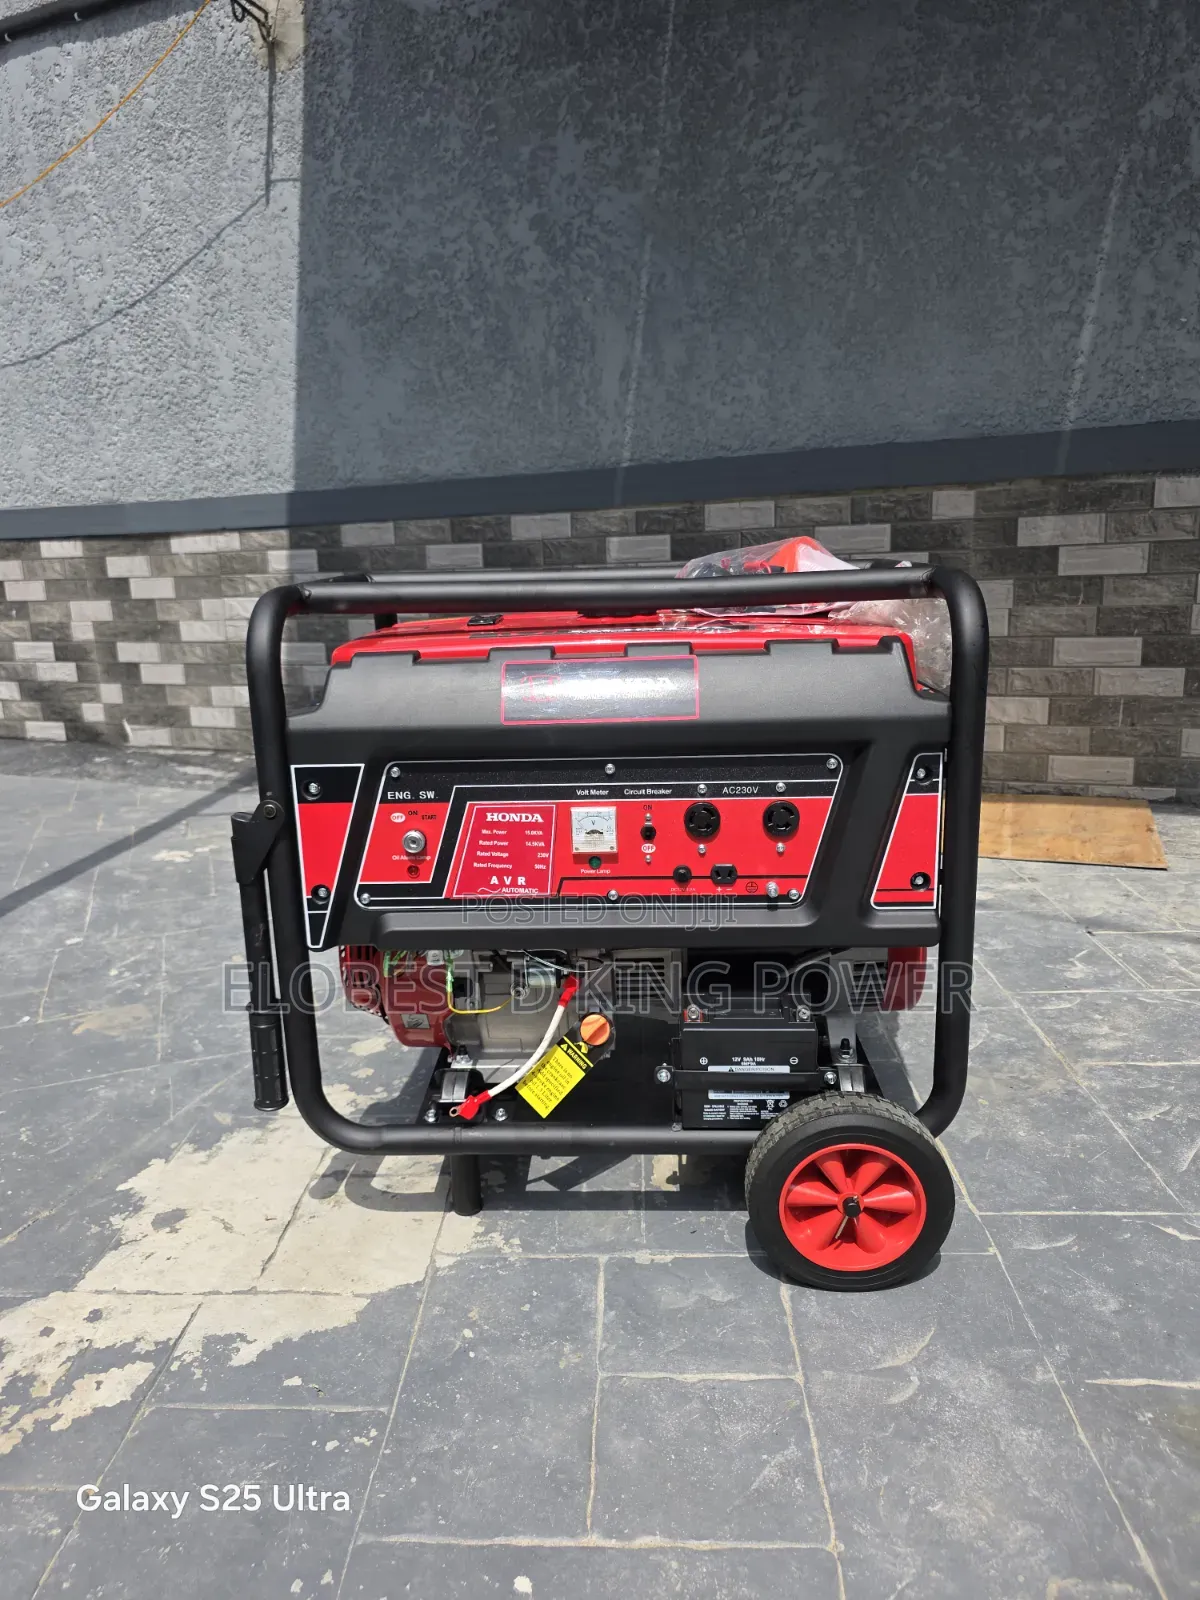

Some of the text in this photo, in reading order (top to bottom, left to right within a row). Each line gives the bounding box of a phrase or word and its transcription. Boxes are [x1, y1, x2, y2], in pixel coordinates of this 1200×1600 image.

[387, 791, 439, 799] ENG. SW.
[722, 786, 759, 794] AC230V
[485, 812, 545, 823] HONDA
[551, 1056, 564, 1069] There
[566, 1047, 587, 1069] WARNING
[545, 1060, 560, 1074] engine
[522, 1079, 537, 1094] before
[544, 1075, 563, 1095] specified
[545, 1086, 559, 1101] engine
